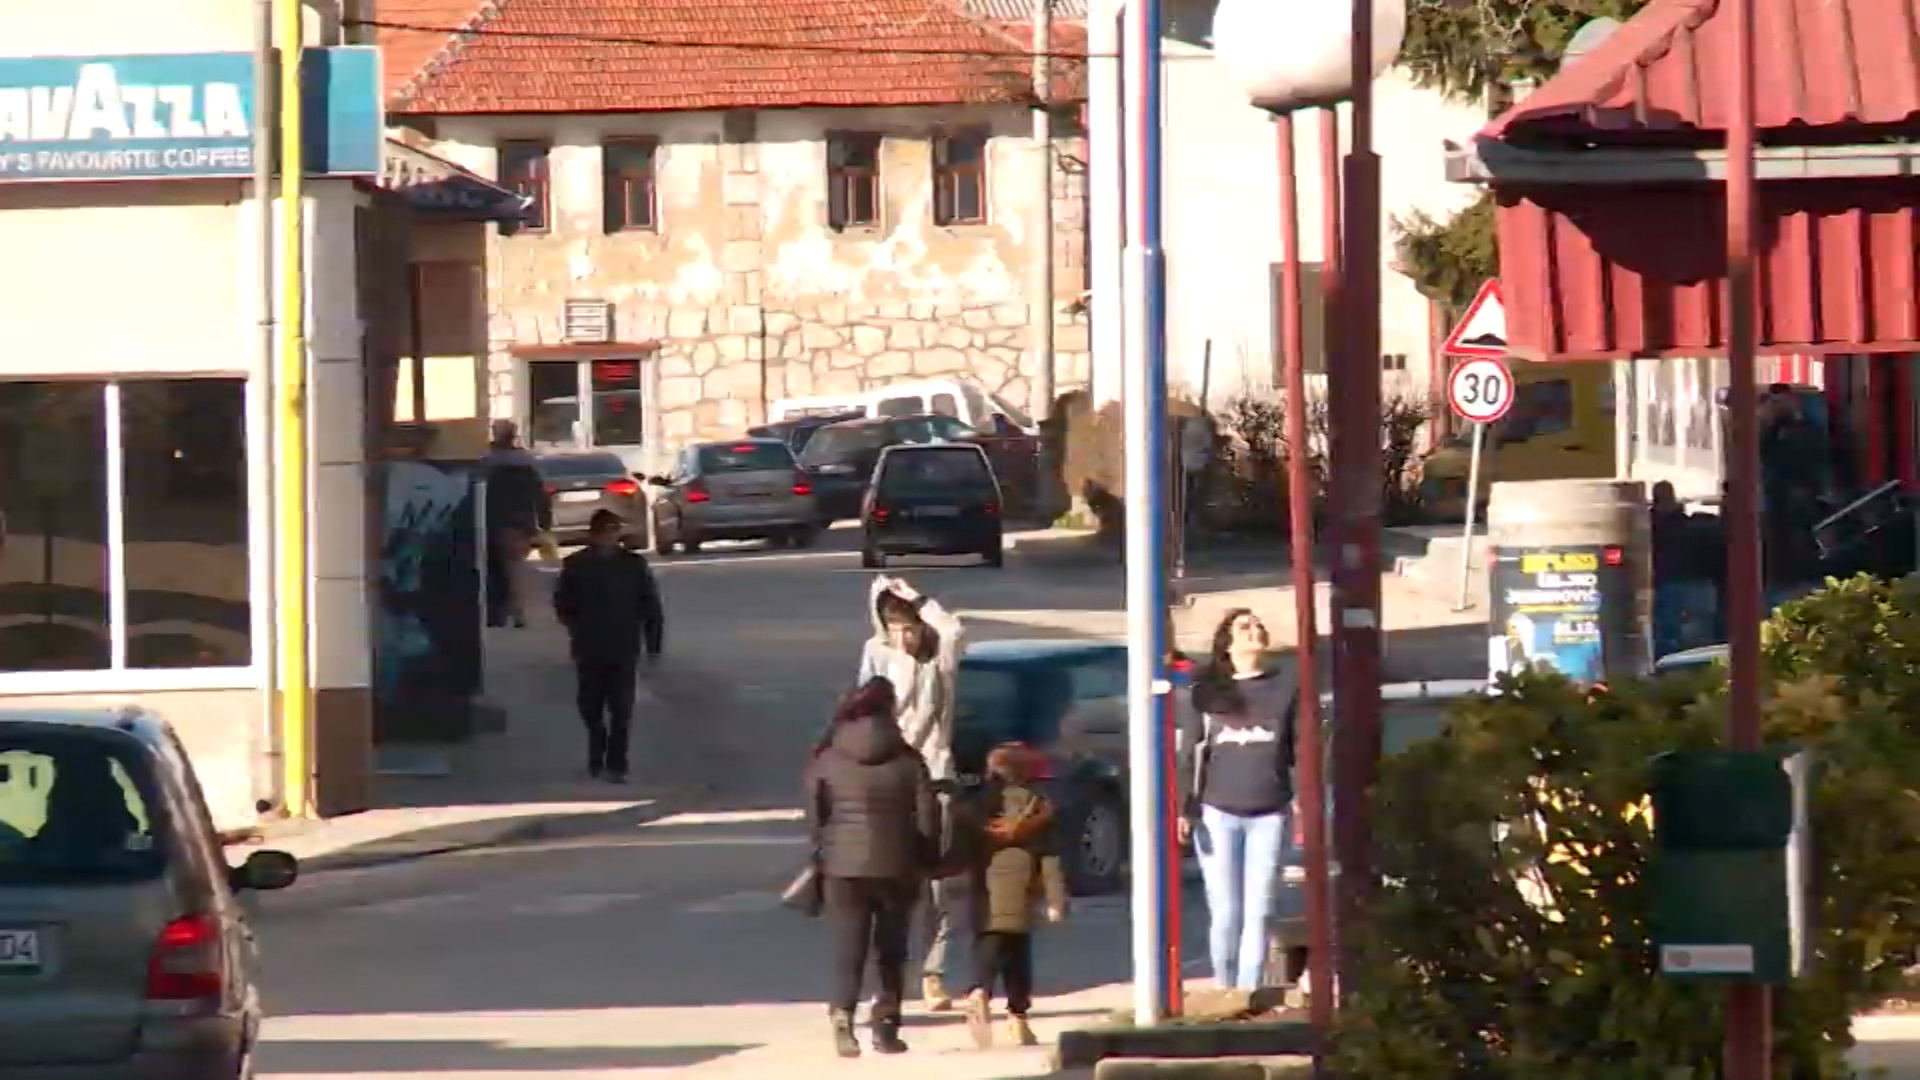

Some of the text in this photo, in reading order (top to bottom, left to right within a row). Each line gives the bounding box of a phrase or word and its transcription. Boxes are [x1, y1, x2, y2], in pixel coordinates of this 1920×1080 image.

[38, 149, 158, 171] FAVOURITE
[162, 147, 250, 169] COFFEE
[1463, 373, 1501, 405] 30
